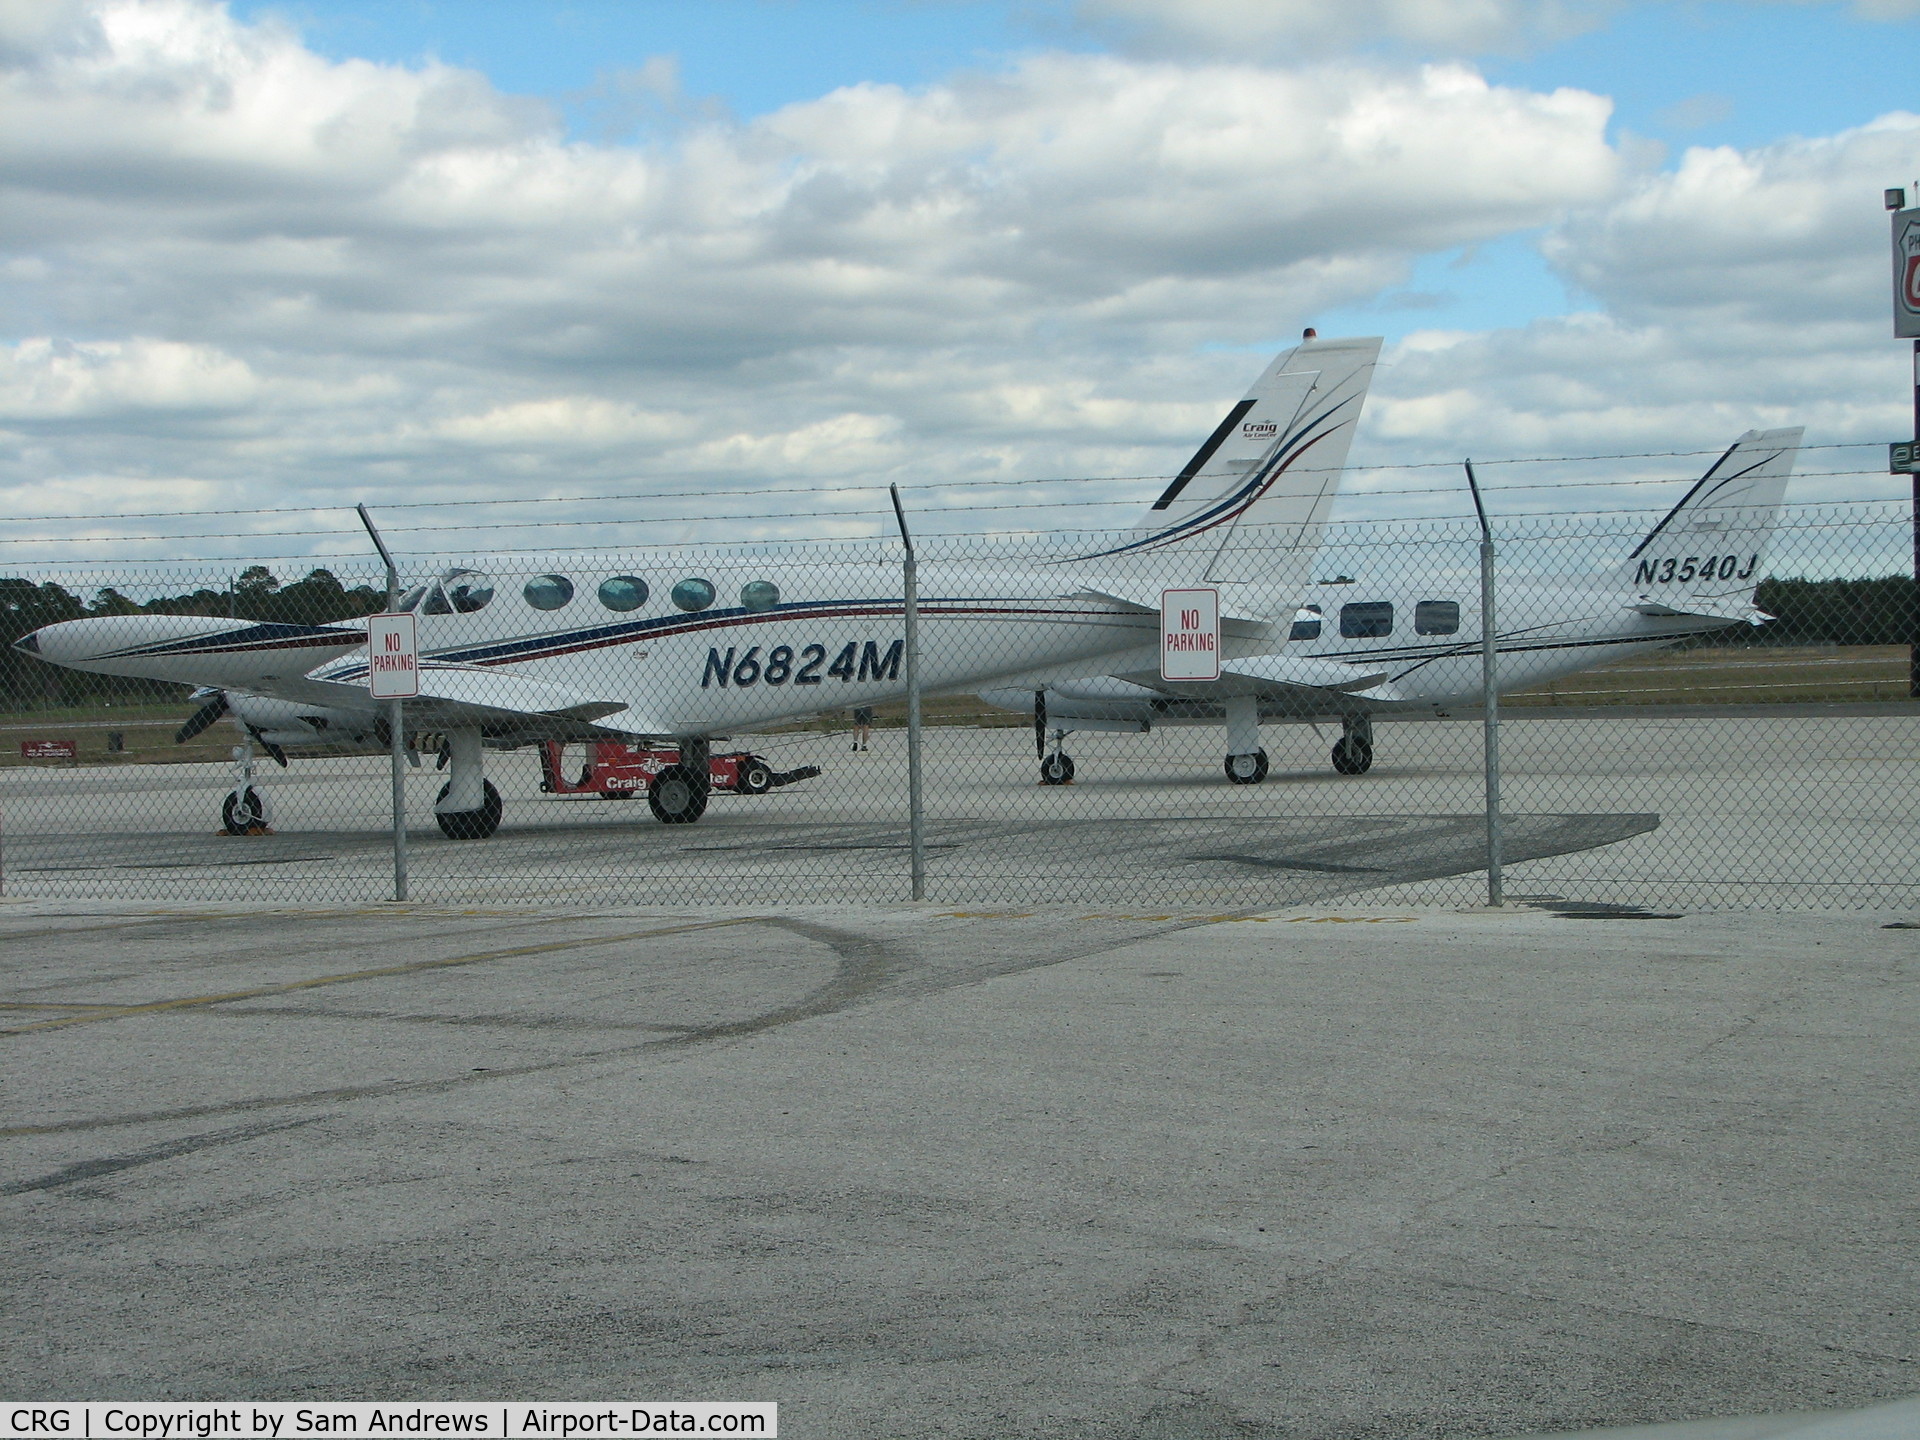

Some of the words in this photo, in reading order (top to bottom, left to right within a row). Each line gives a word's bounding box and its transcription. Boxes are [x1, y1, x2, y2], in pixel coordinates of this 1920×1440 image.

[1243, 423, 1277, 433] Craig
[1634, 552, 1758, 584] N3540J
[1181, 609, 1199, 630] NO
[385, 633, 400, 652] NO
[1167, 633, 1214, 651] PARKING
[374, 654, 413, 672] PARKING
[701, 640, 904, 689] N6824M
[606, 776, 647, 790] Craig
